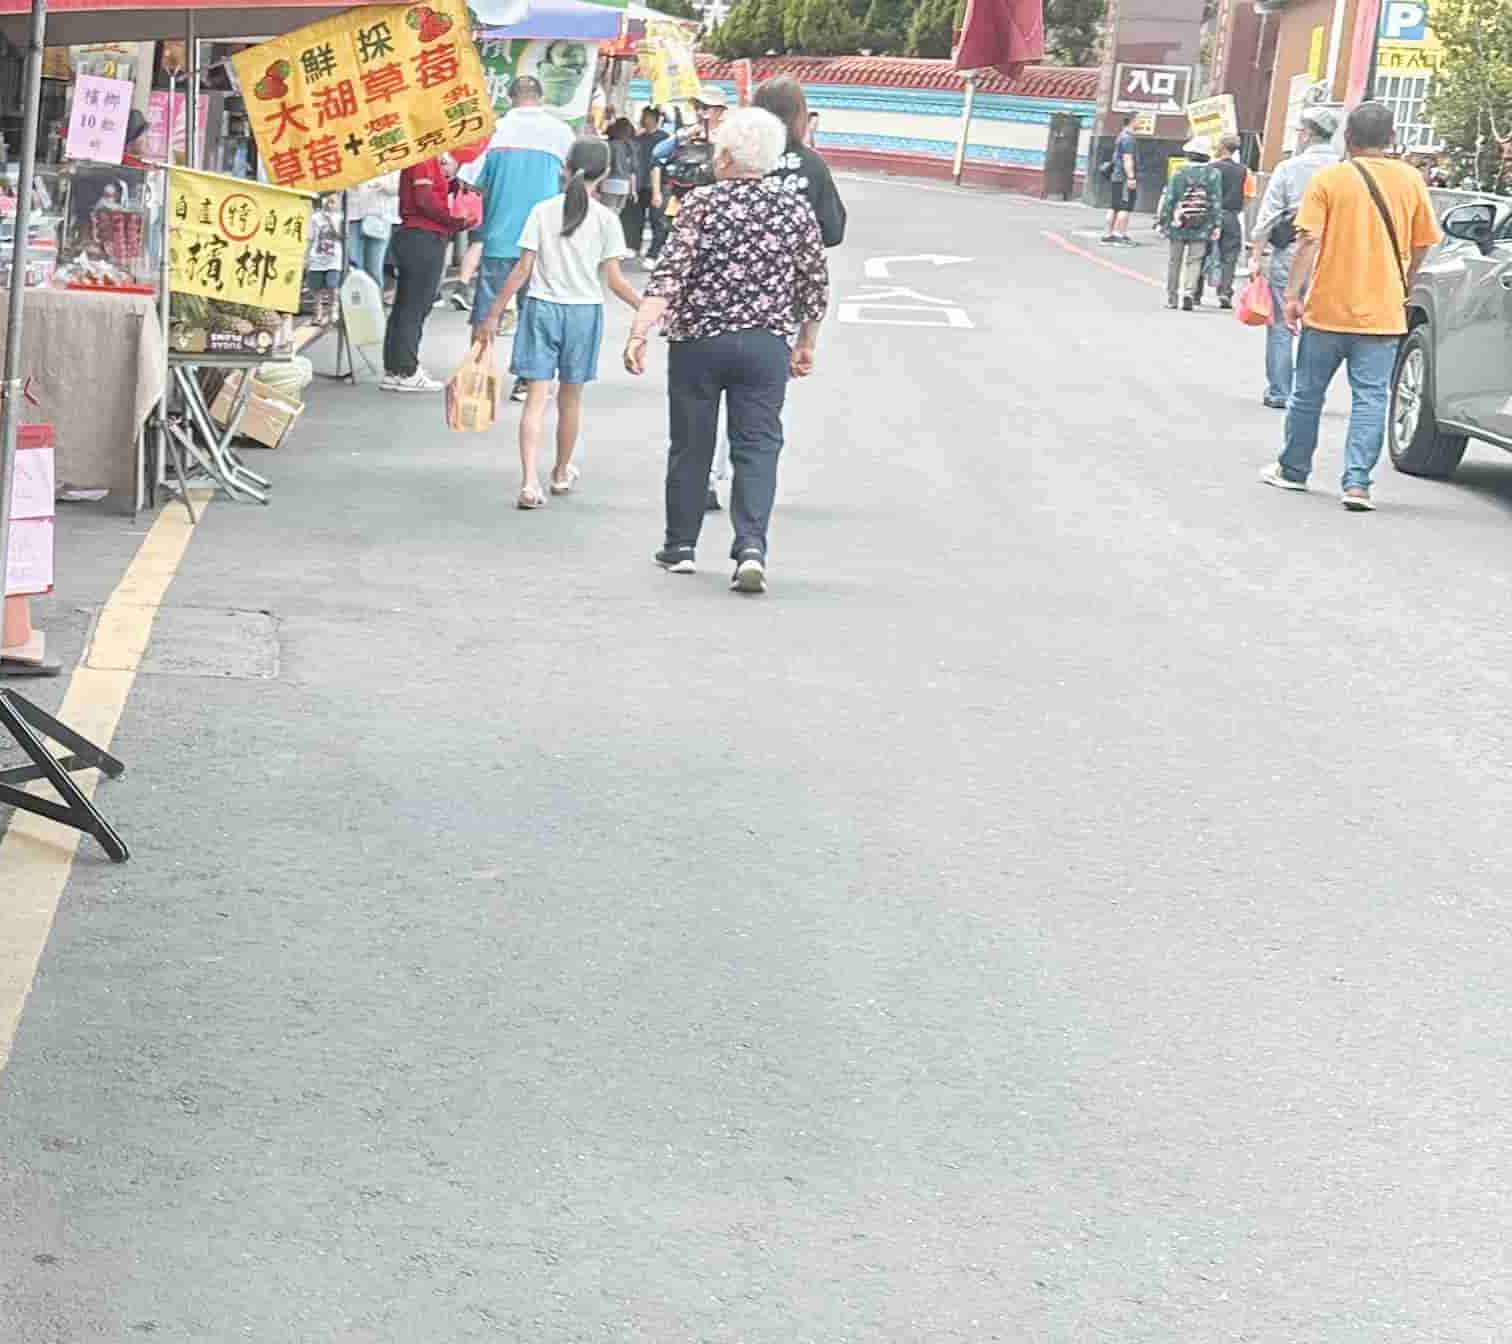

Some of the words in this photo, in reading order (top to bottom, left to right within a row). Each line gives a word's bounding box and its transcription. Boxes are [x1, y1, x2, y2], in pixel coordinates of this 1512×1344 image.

[1384, 2, 1424, 38] P
[264, 41, 460, 145] 大湖草莓
[1127, 69, 1178, 96] 入口
[185, 234, 278, 297] 檳榔
